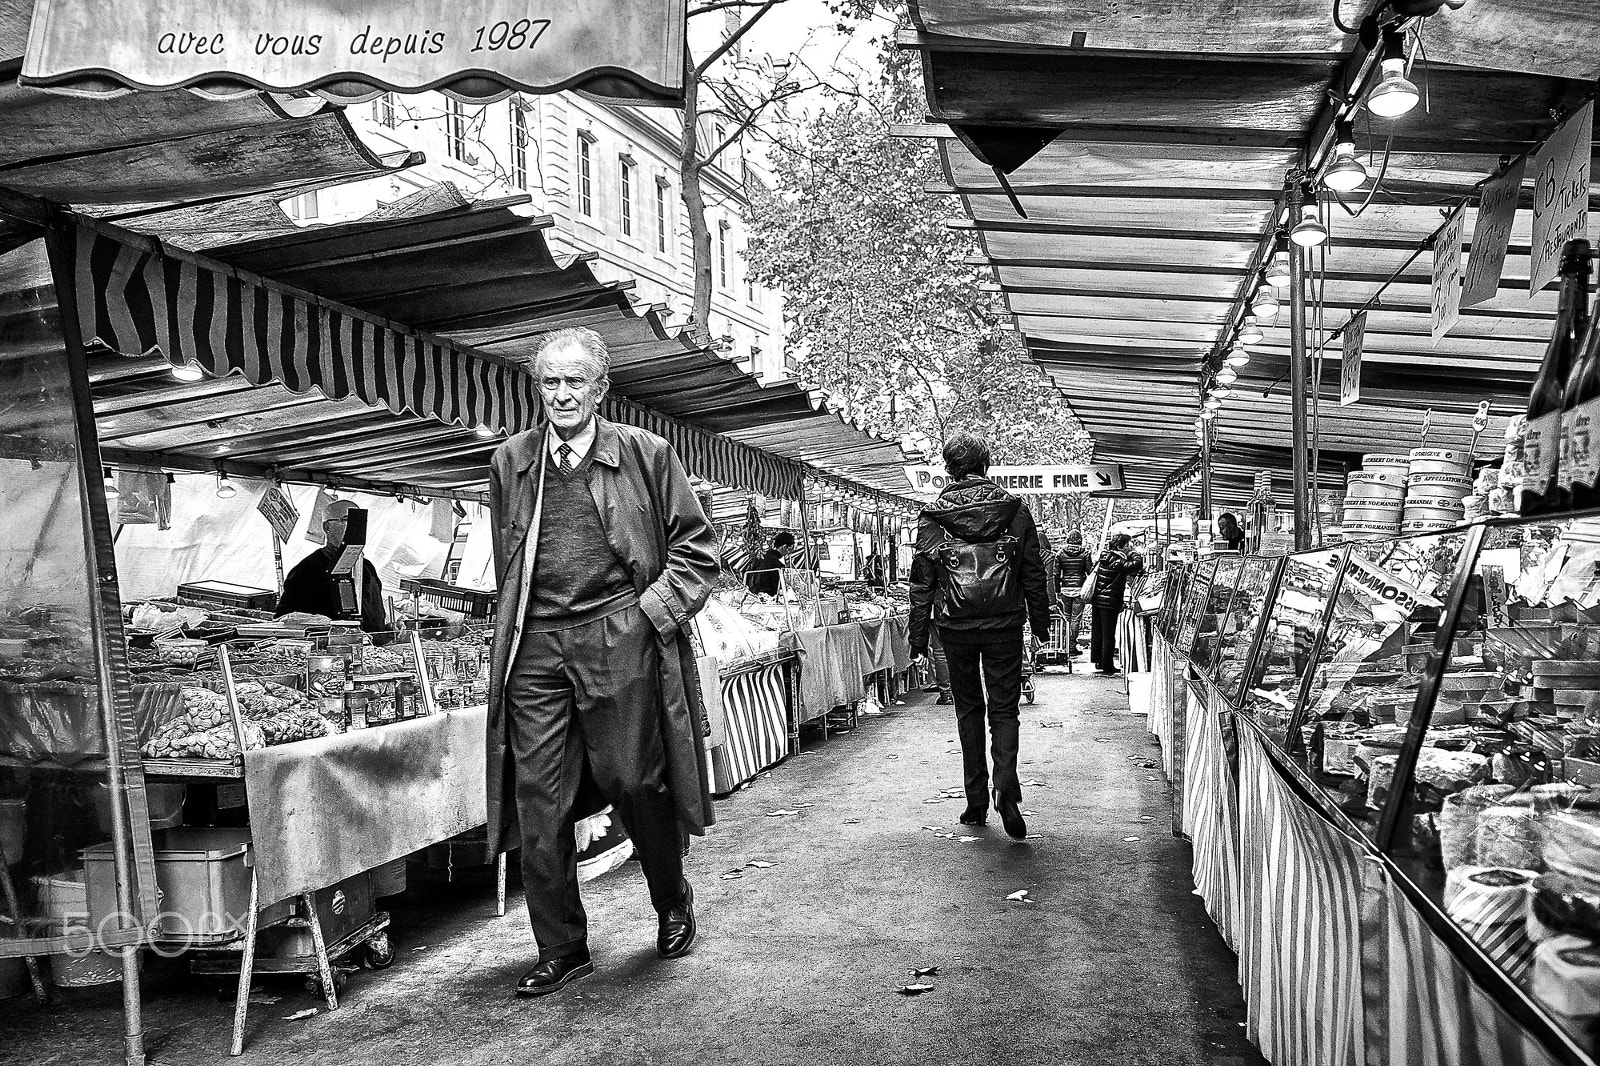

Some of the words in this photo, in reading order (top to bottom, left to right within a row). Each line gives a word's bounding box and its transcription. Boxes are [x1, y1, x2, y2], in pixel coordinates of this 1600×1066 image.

[156, 32, 226, 56] avec
[254, 33, 323, 56] vous
[349, 25, 446, 63] depuis
[469, 18, 552, 53] 1987
[1053, 473, 1089, 488] FINE
